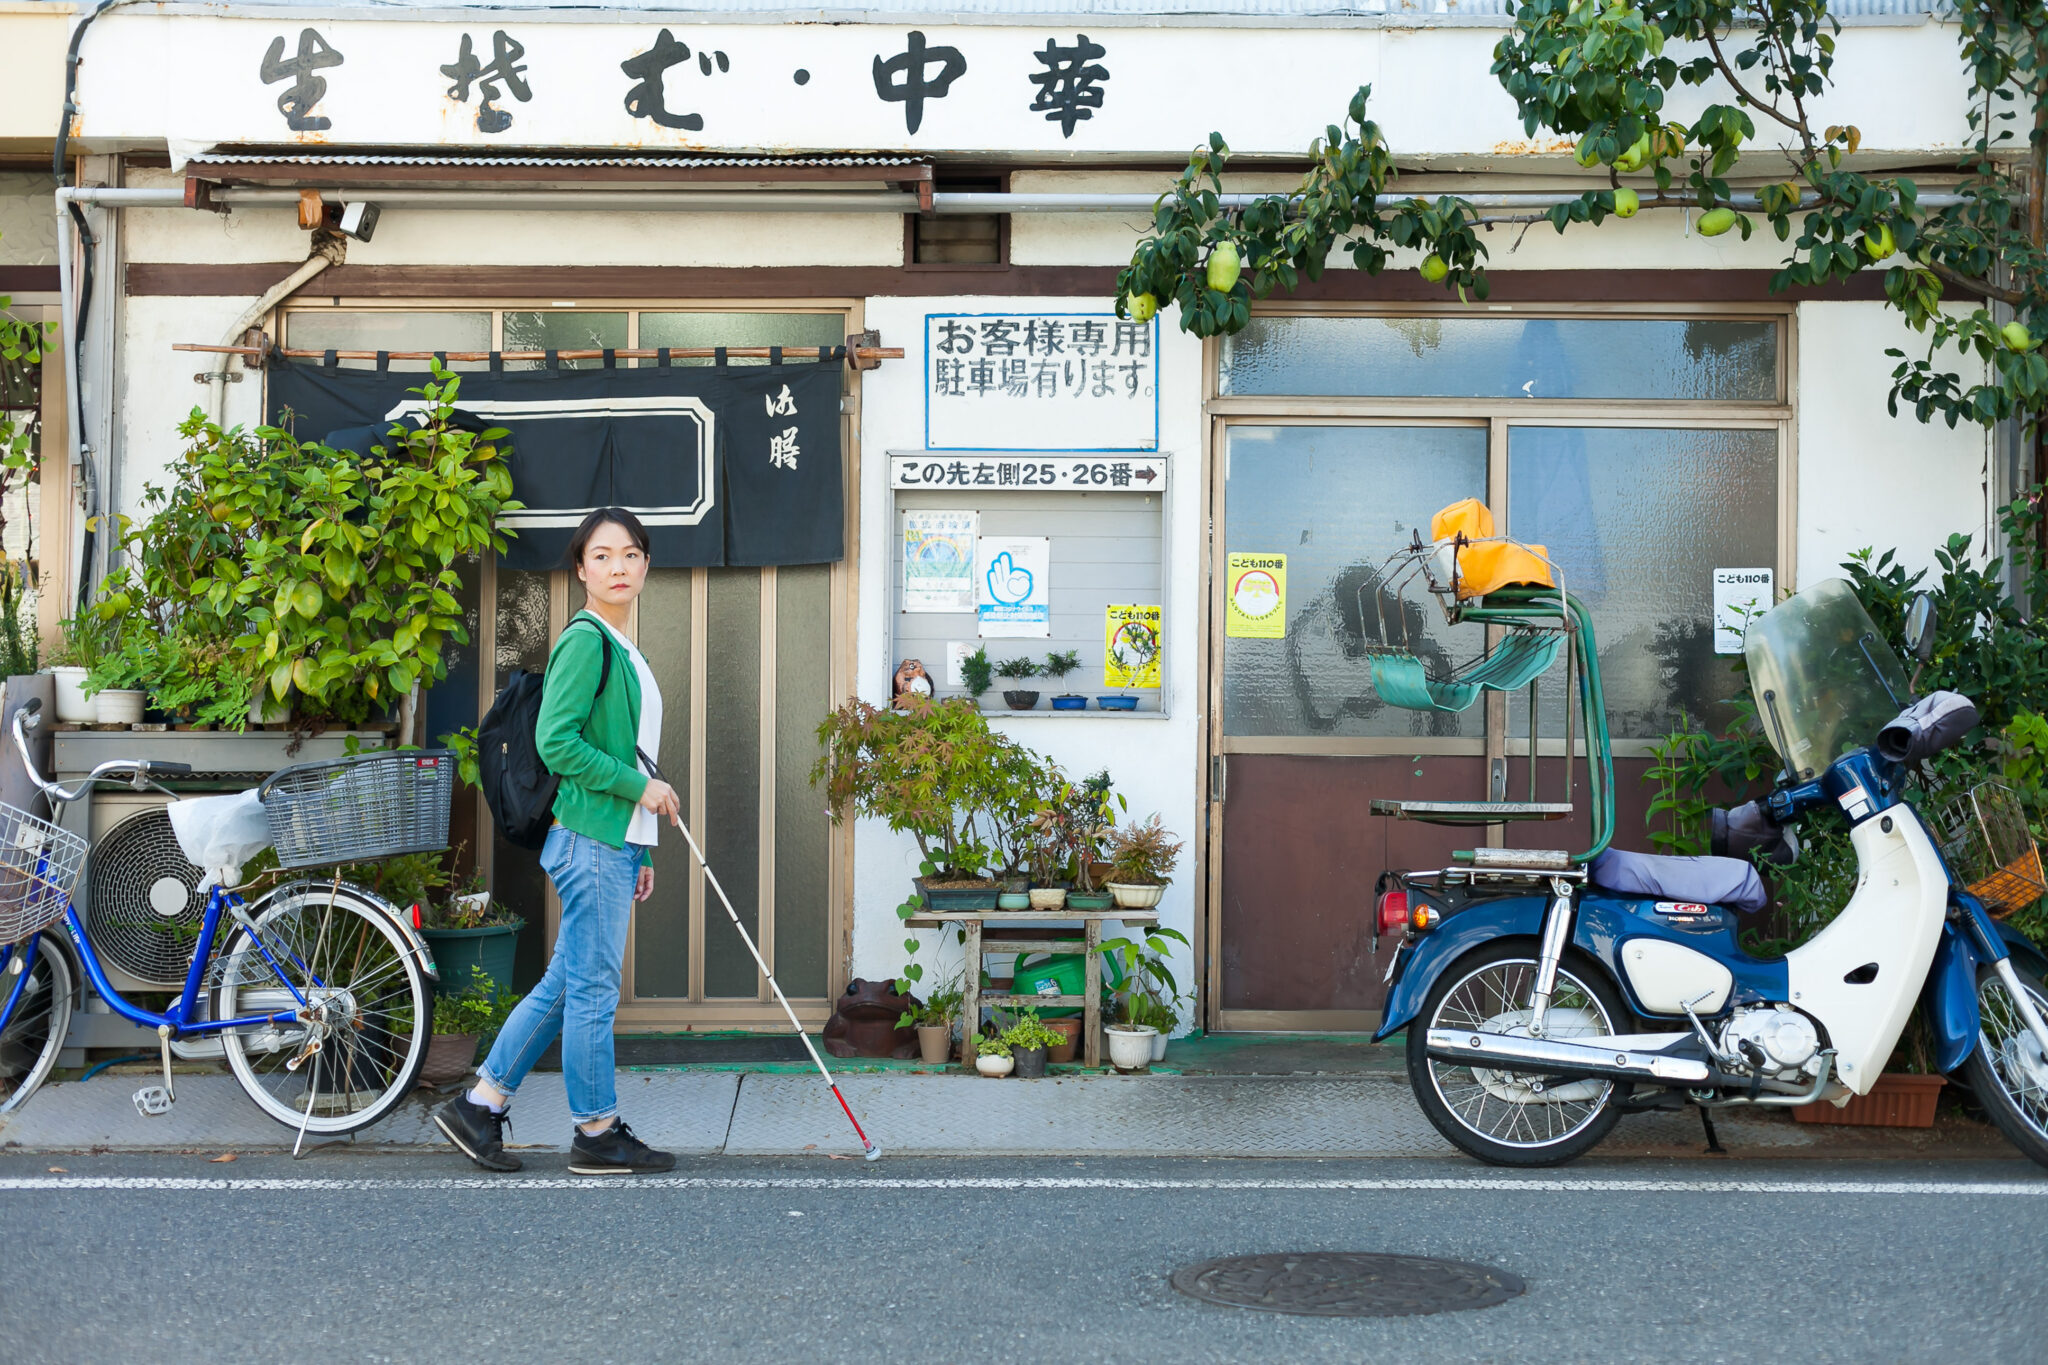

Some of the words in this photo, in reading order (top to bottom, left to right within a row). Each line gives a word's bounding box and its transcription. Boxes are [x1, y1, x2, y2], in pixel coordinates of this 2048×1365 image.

[936, 318, 1151, 358] お客様専用
[935, 357, 1155, 399] 駐車場有ります。
[899, 460, 1133, 488] この先左側25・26番
[1231, 558, 1284, 569] こども110番
[1717, 573, 1770, 584] こども110番
[1109, 610, 1160, 621] こども110番
